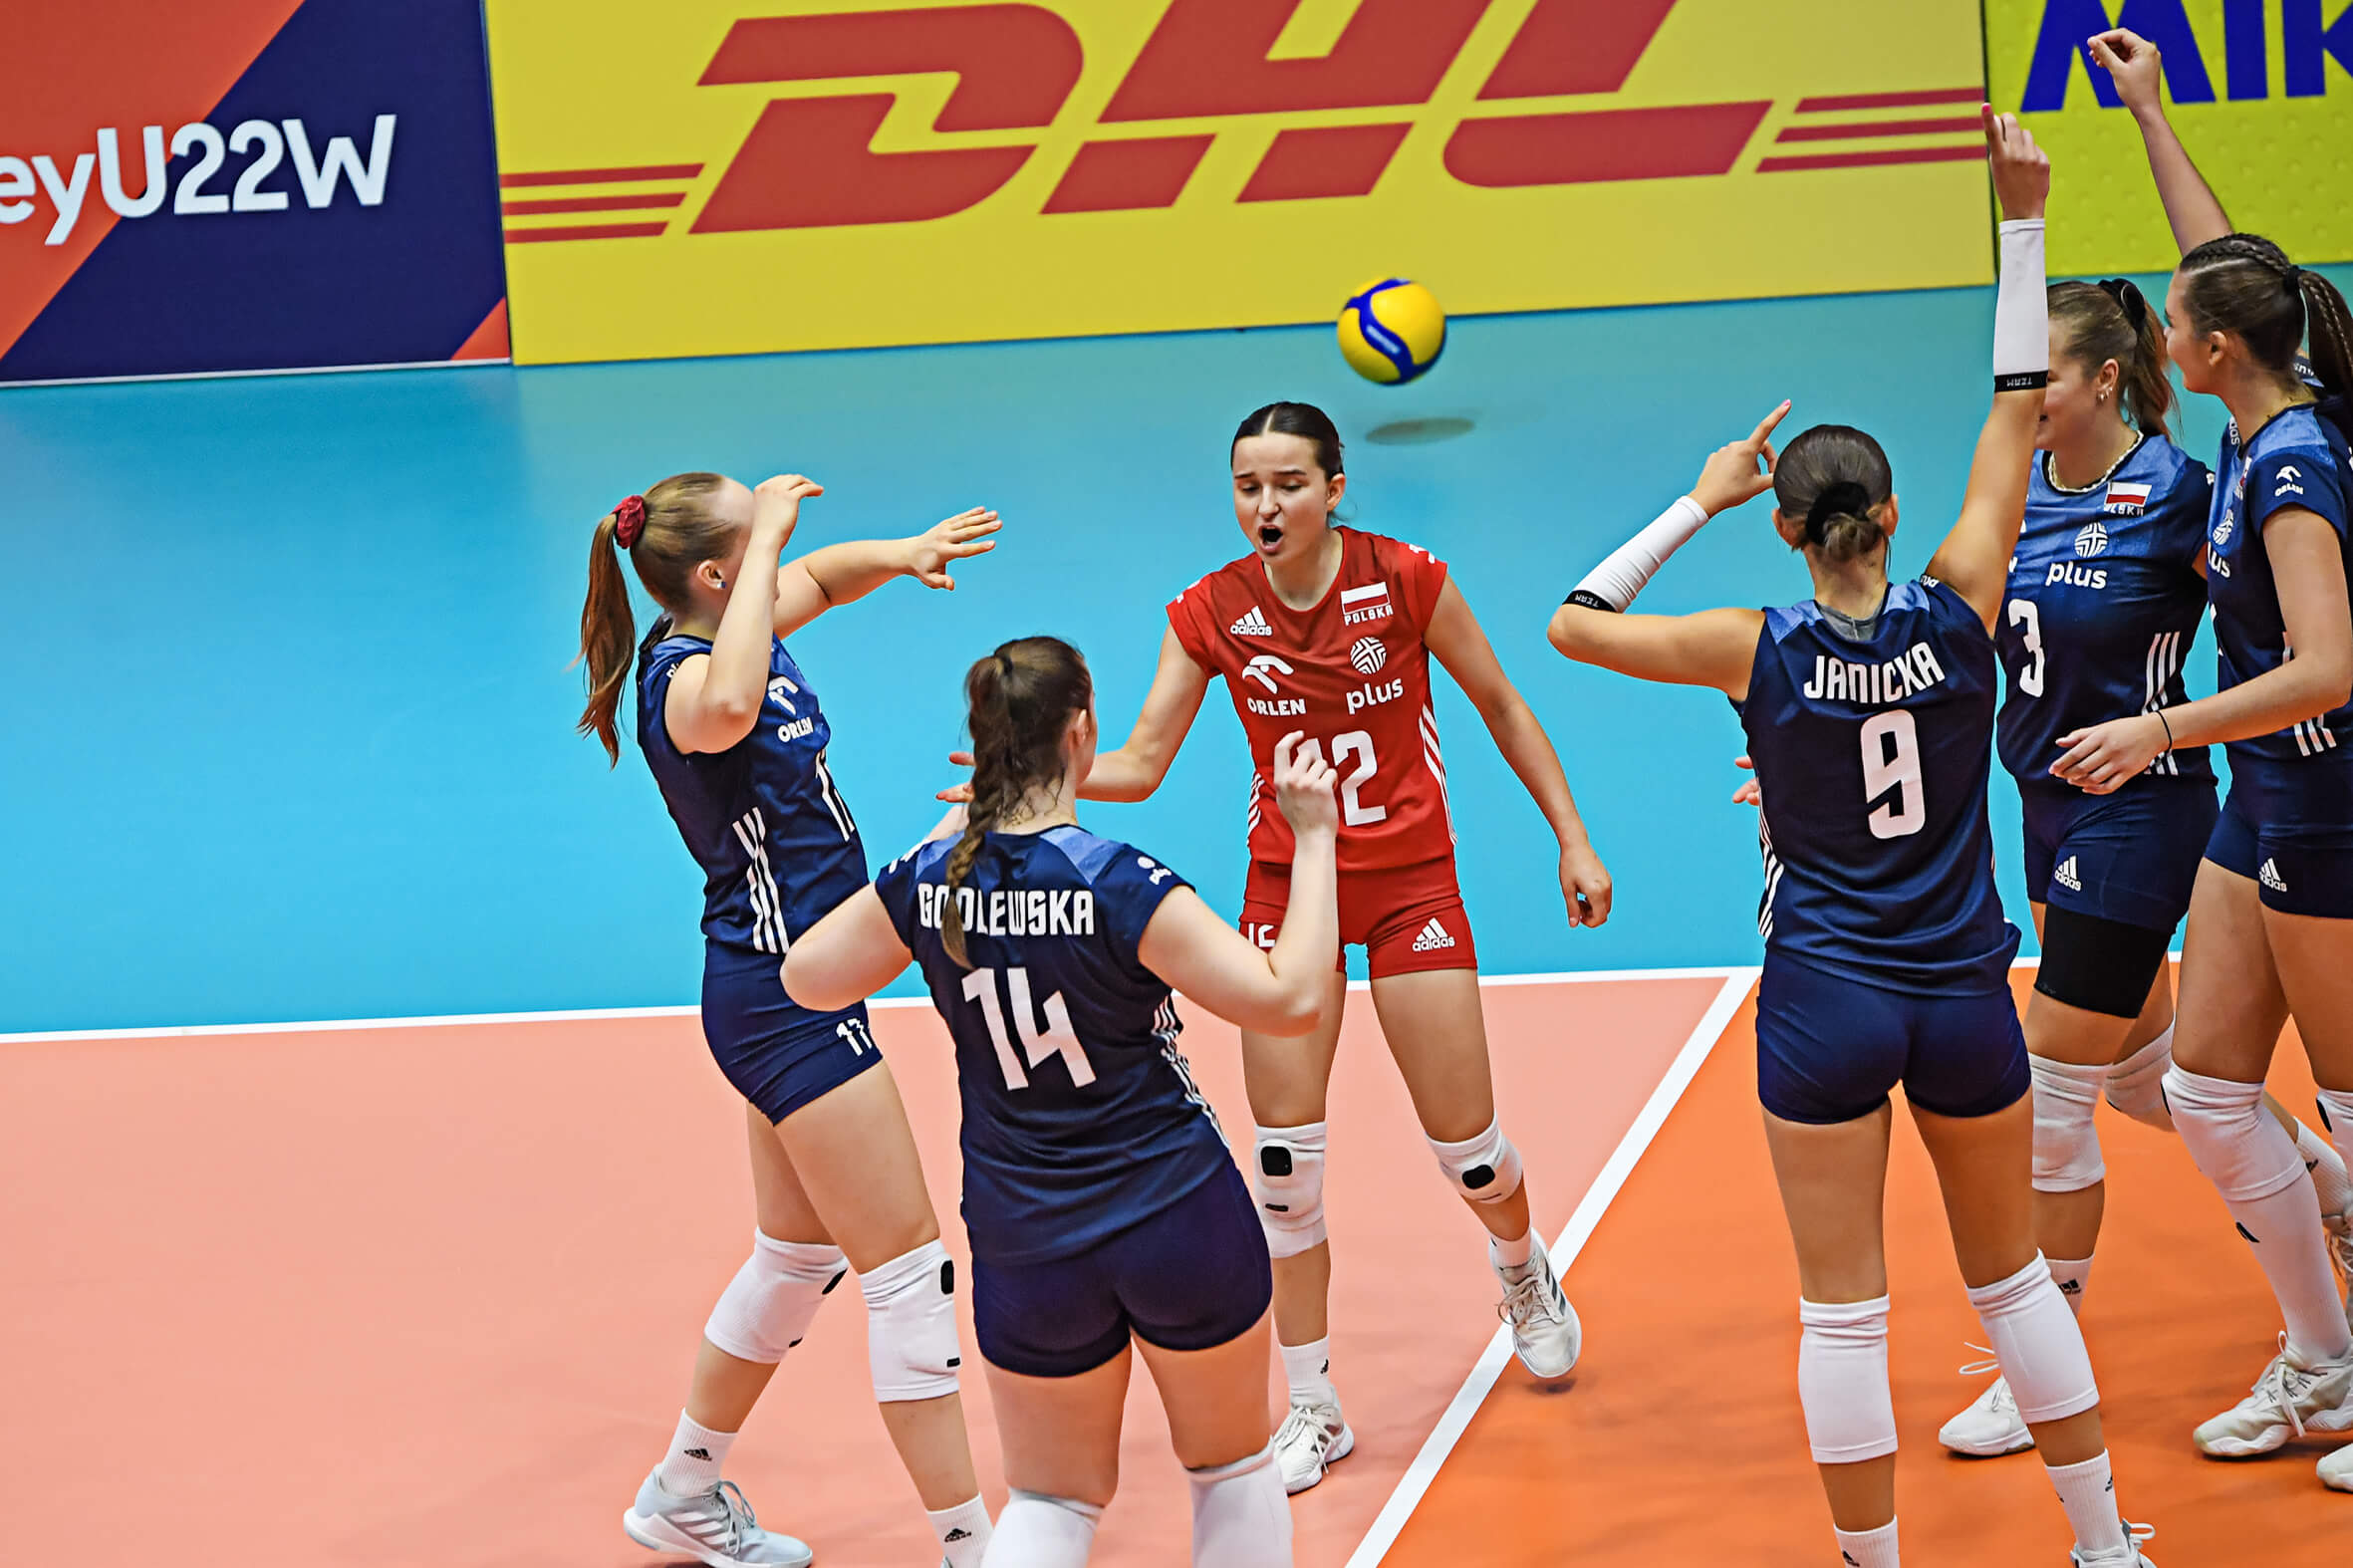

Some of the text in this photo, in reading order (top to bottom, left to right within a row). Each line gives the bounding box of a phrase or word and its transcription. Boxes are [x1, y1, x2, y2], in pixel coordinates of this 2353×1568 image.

[687, 0, 1774, 235] DHL
[2045, 561, 2108, 590] plus
[2208, 541, 2231, 578] lus
[1229, 623, 1273, 637] adidas
[1344, 604, 1394, 627] POLSKA
[2007, 598, 2045, 698] 3
[1803, 641, 1946, 704] JANICKA
[1246, 696, 1307, 716] ORLEN
[1346, 677, 1404, 715] plus
[1860, 708, 1927, 840] 9
[1412, 936, 1455, 952] adidas
[961, 966, 1097, 1091] 14
